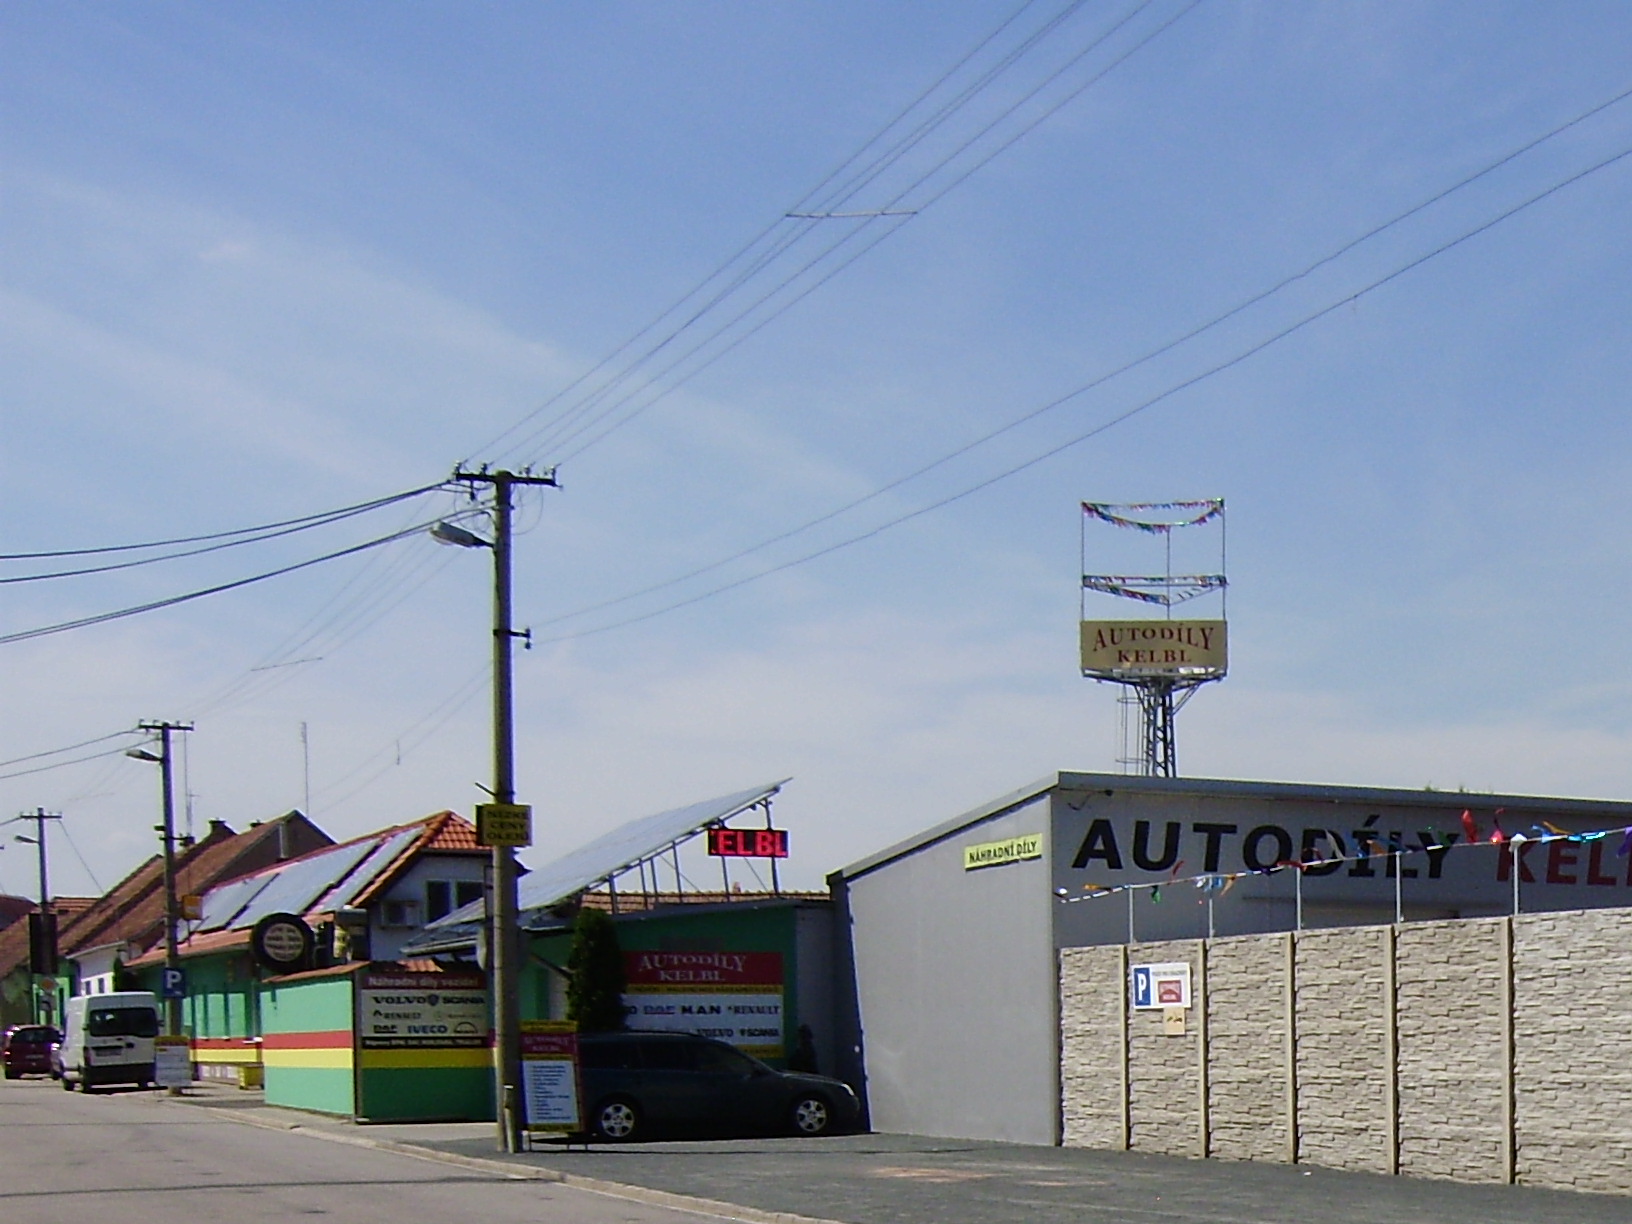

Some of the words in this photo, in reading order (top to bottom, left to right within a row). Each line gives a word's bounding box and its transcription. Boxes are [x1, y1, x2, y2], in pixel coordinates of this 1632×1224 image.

[1093, 623, 1214, 651] AUTODÍLY
[1118, 650, 1192, 663] KELBL
[711, 830, 788, 857] ELBL
[969, 842, 1014, 863] NÁHRADNÍ
[1016, 839, 1037, 856] DÍLY
[1071, 814, 1461, 879] AUTODÍLY
[638, 954, 747, 973] AUTODÍLY
[166, 970, 182, 989] P
[659, 969, 726, 981] KELBL
[1137, 973, 1147, 1001] P
[372, 996, 426, 1004] VOLVO
[443, 996, 486, 1004] SCANIA
[681, 1005, 721, 1014] MAN
[734, 1005, 780, 1014] RENAULT
[407, 1024, 448, 1034] IVECO
